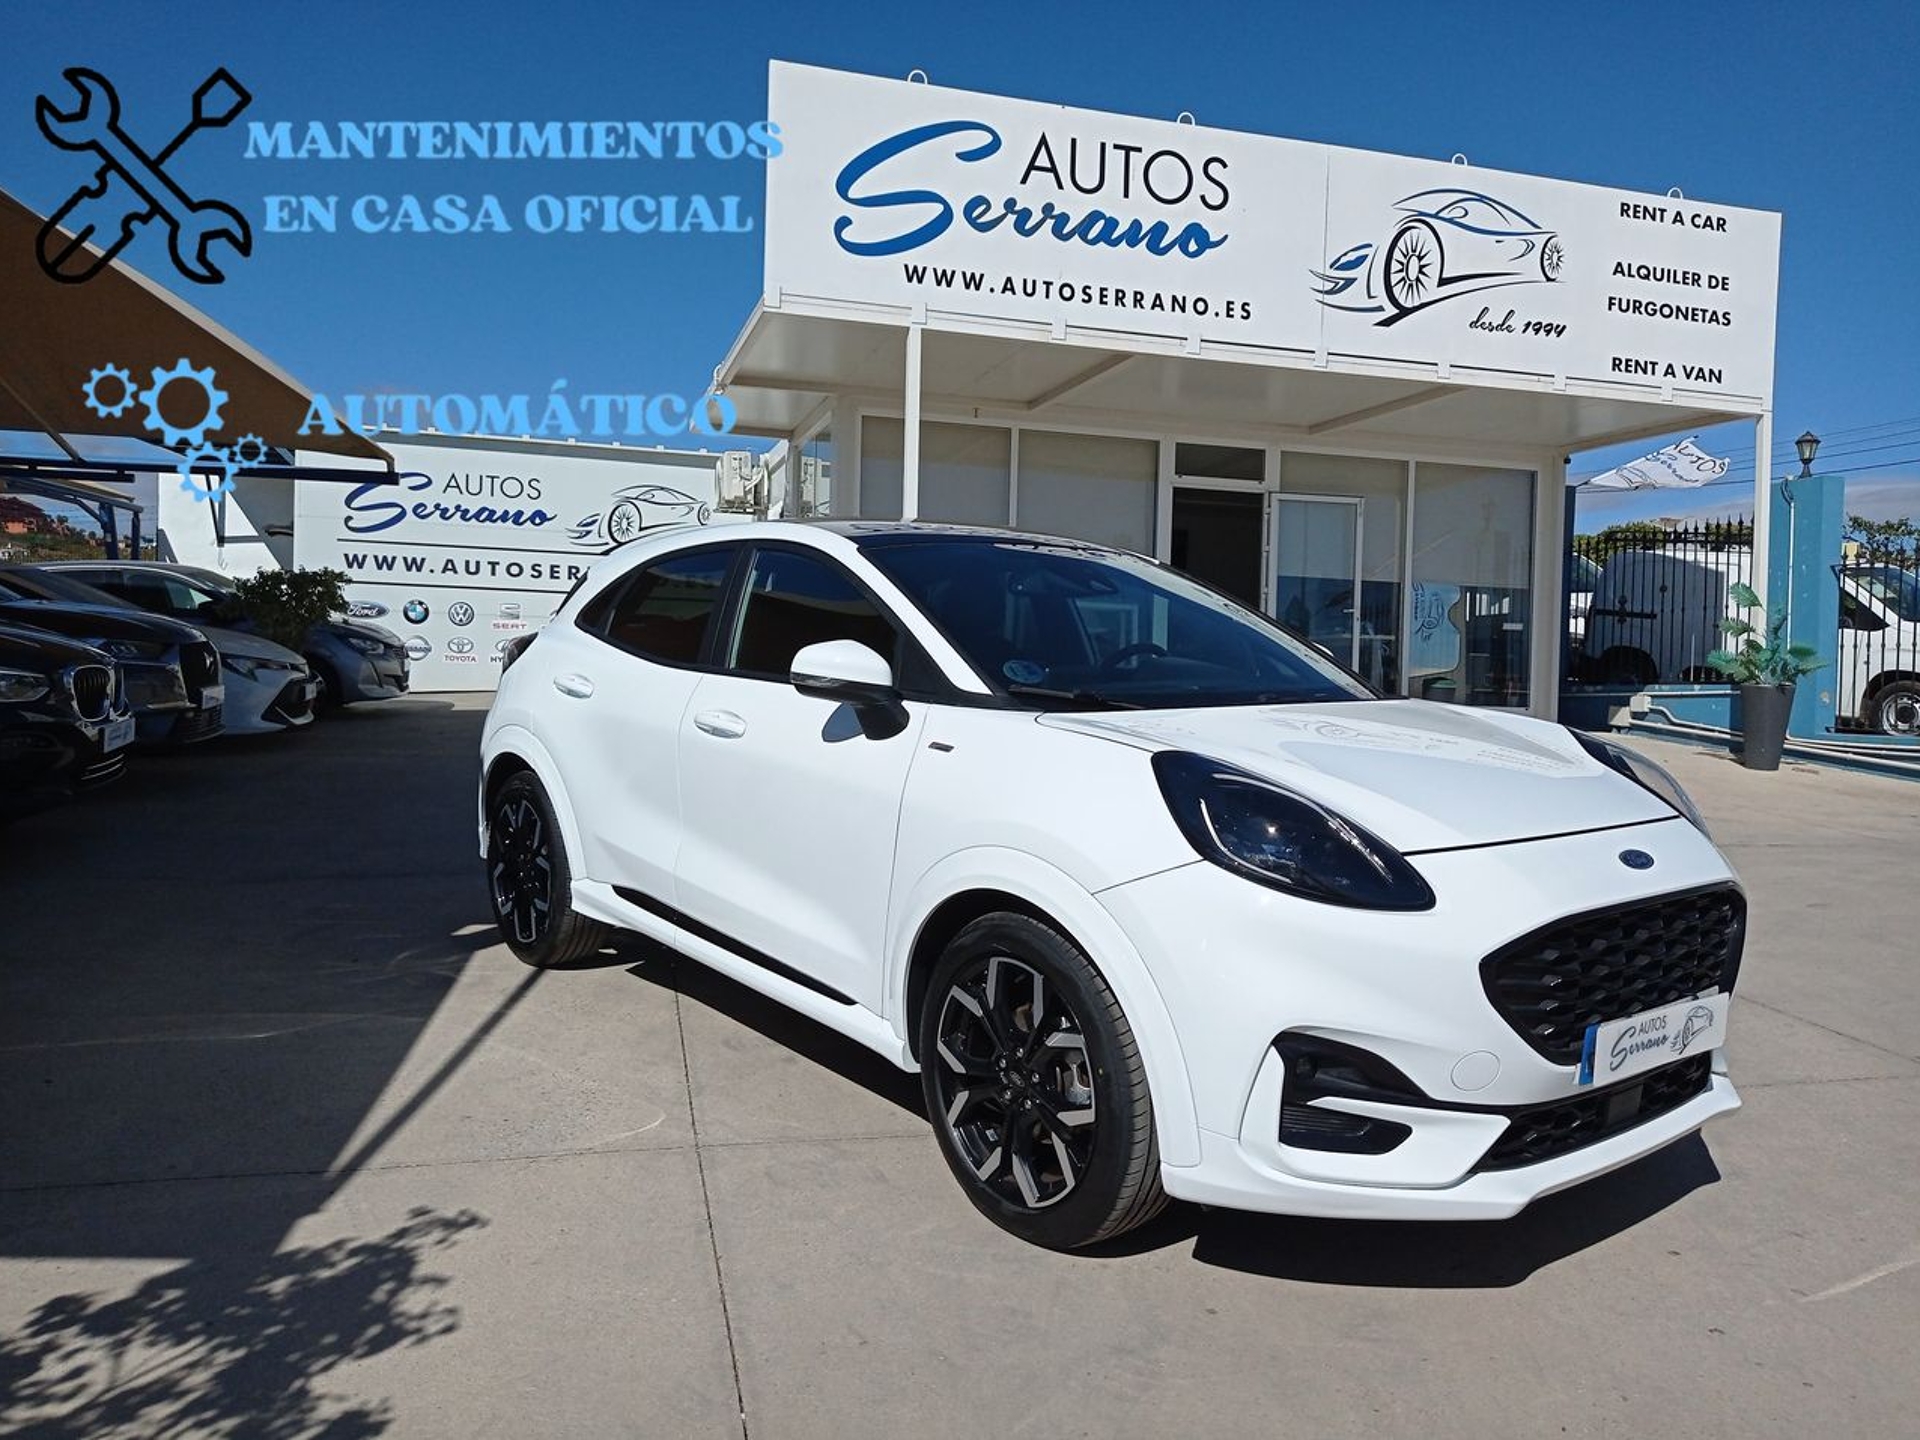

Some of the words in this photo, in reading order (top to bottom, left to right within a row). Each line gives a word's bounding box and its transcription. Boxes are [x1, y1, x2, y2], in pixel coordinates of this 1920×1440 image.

[1020, 131, 1230, 212] AUTOS
[833, 120, 1229, 259] Serrano
[1620, 202, 1668, 226] RENT
[1671, 212, 1686, 227] A
[1691, 214, 1728, 233] CAR
[903, 263, 1252, 321] WWW.AUTOSERRANO.ES
[1612, 261, 1703, 287] ALQUILER
[1707, 274, 1730, 292] DE
[1469, 306, 1515, 334] desde
[1521, 321, 1567, 338] 1994
[1607, 296, 1732, 327] FURGONETAS
[1611, 356, 1658, 378] RENT
[1661, 363, 1677, 380] A
[1682, 366, 1723, 384] VAN
[442, 473, 541, 500] AUTOS
[344, 472, 557, 533] Serrano
[444, 654, 477, 663] TOYOTA
[1638, 1015, 1667, 1036] AUTOS
[1610, 1025, 1670, 1071] Serrano
